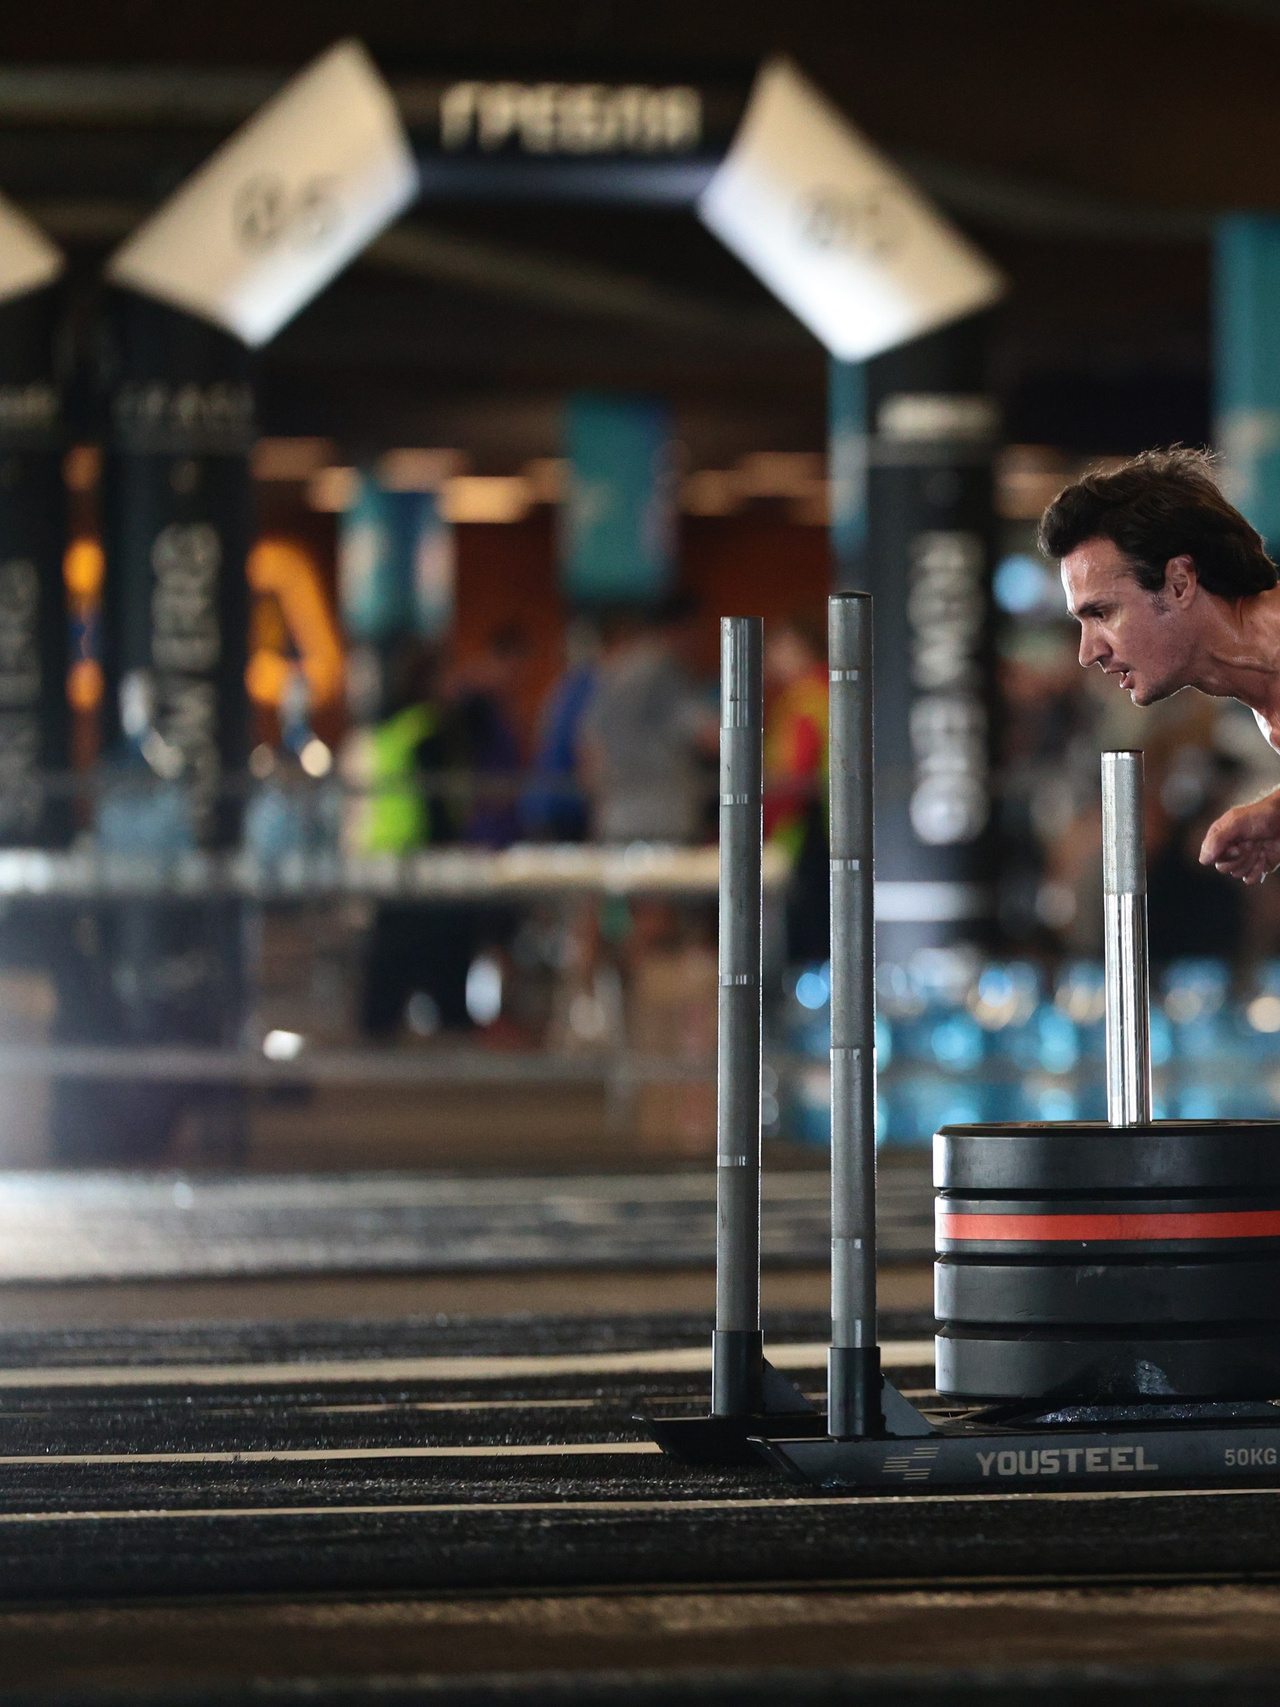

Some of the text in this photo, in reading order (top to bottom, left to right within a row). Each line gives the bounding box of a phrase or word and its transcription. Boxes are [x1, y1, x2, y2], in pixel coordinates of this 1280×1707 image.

[440, 82, 701, 153] ГРЕБЛЯ
[976, 1447, 1159, 1476] YOUSTEEL
[1225, 1448, 1277, 1466] 50KG
